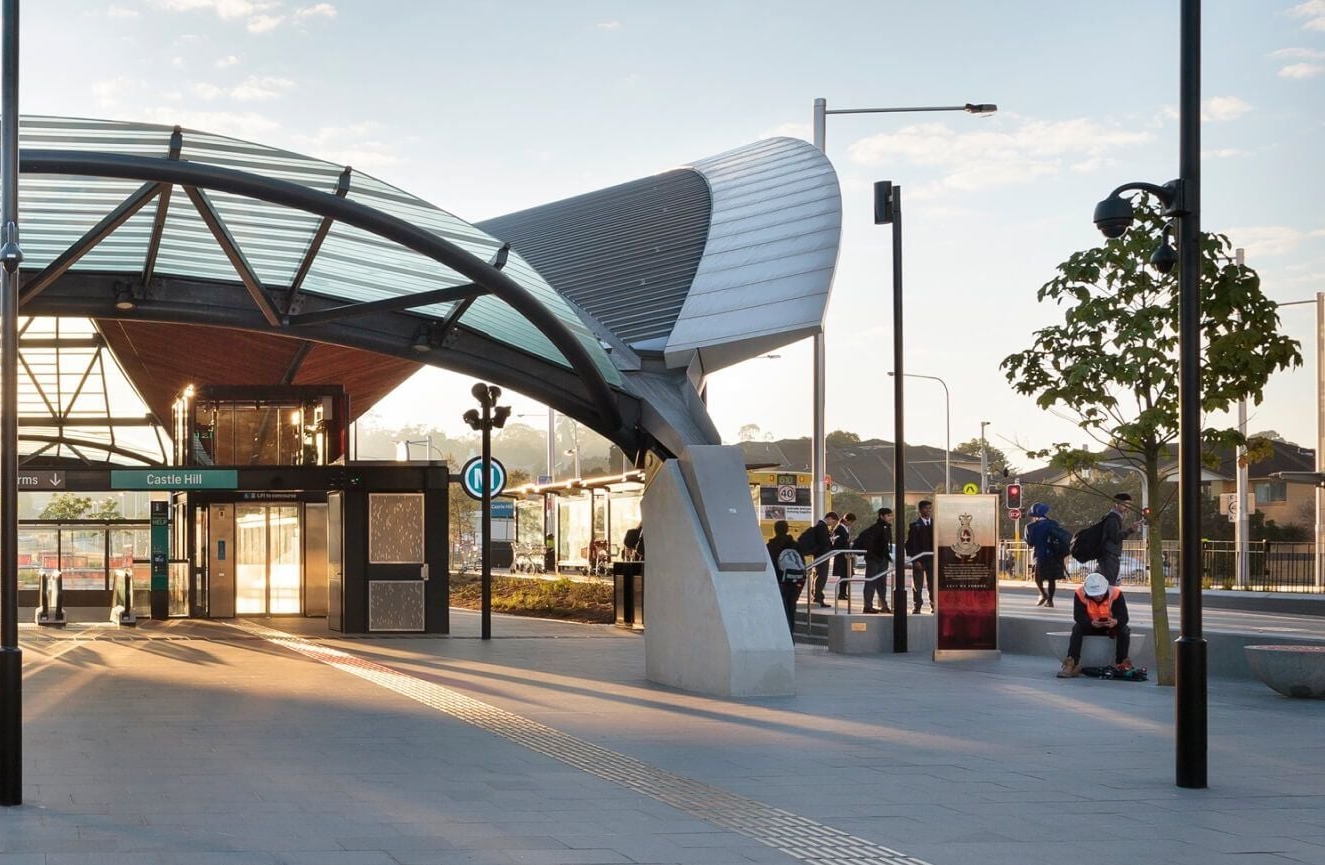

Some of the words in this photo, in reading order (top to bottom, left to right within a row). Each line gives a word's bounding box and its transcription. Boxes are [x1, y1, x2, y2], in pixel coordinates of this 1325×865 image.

[146, 474, 182, 485] Castle
[184, 473, 202, 485] Hill
[780, 489, 793, 498] 40
